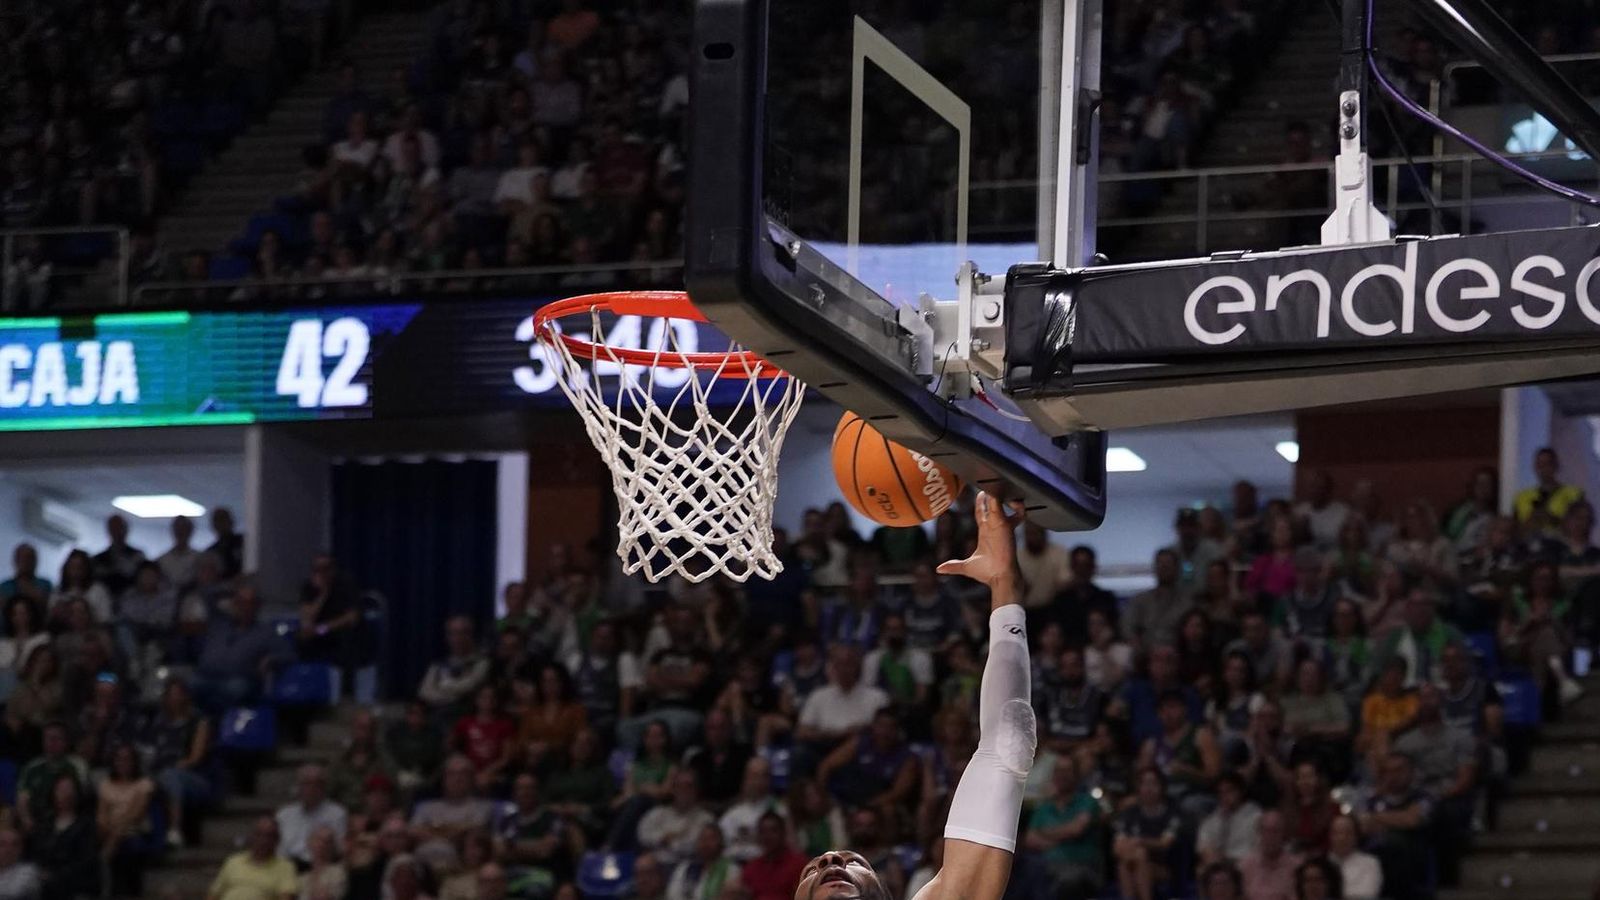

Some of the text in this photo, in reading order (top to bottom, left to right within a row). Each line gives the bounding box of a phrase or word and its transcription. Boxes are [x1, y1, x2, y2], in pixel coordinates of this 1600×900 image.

[0, 317, 371, 408] CAJA 42
[877, 492, 899, 520] acb
